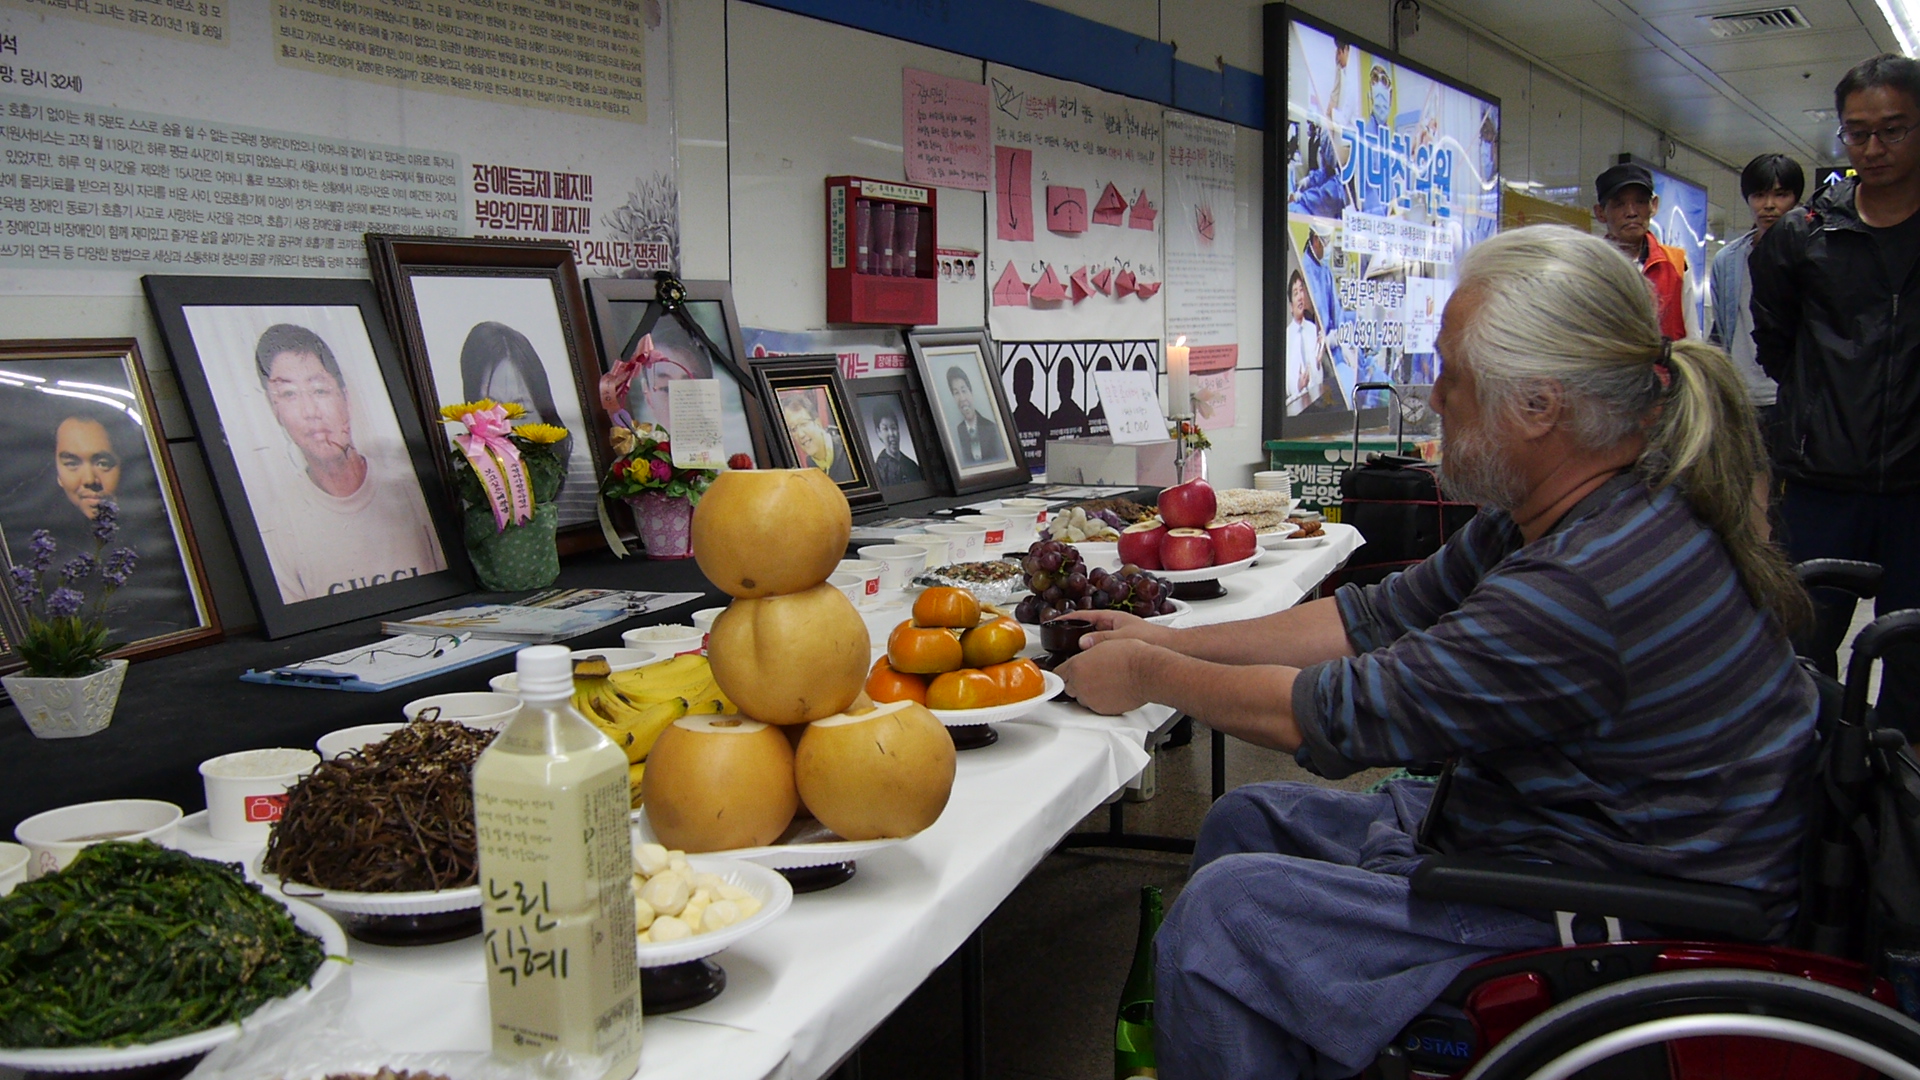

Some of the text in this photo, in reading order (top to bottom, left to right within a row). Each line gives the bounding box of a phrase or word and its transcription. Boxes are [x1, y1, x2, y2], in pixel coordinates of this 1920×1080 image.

[94, 2, 222, 40] 그녀는 결국 2013년 1월 26일
[280, 26, 304, 39] 보내고
[298, 49, 316, 62] 사는
[21, 68, 47, 89] 당시
[51, 72, 83, 93] 32세)
[1059, 96, 1077, 119] 접기
[0, 126, 66, 145] 지원서비스는
[92, 135, 102, 150] 월
[146, 142, 168, 155] 하루
[168, 145, 188, 159] 평균
[190, 148, 224, 162] 4시간이
[236, 153, 254, 166] 되지
[8, 103, 42, 119] 호흡기
[46, 107, 80, 124] 없이는
[84, 112, 94, 126] 채
[98, 115, 126, 129] 5분도
[128, 119, 158, 133] 스스로
[160, 123, 180, 137] 숨을
[196, 127, 206, 140] 수
[210, 129, 228, 143] 없는
[230, 131, 258, 146] 근육병
[350, 147, 366, 159] 같이
[368, 150, 382, 161] 살고
[408, 154, 430, 166] 이유로
[58, 155, 80, 169] 하루
[84, 157, 96, 171] 약
[98, 159, 136, 175] 9시간을
[140, 164, 170, 178] 제외한
[174, 168, 212, 182] 15시간은
[214, 171, 244, 184] 어머니
[246, 173, 264, 186] 홀로
[302, 179, 318, 192] 하는
[391, 188, 406, 199] 이미
[1341, 119, 1411, 209] 기대찬
[20, 174, 76, 192] 물리치료를
[78, 180, 110, 194] 받으러
[112, 182, 134, 196] 잠시
[136, 185, 166, 199] 자리를
[168, 187, 188, 201] 비운
[214, 191, 266, 206] 인공호흡기에
[268, 196, 294, 209] 이상이
[473, 163, 593, 202] 장애등급제 폐지!!
[0, 196, 26, 212] 육병
[28, 198, 64, 214] 장애인
[66, 200, 98, 215] 동료가
[100, 203, 132, 217] 호흡기
[134, 207, 164, 219] 사고로
[168, 209, 204, 223] 사망하는
[206, 212, 234, 225] 사건을
[266, 215, 292, 228] 호흡기
[294, 217, 310, 229] 사용
[475, 199, 591, 234] 부양의무제 폐지!!
[6, 220, 50, 235] 장애인과
[54, 223, 106, 238] 비장애인이
[108, 225, 128, 239] 함께
[130, 227, 168, 240] 재미있고
[170, 229, 198, 243] 즐거운
[220, 232, 254, 246] 살아가는
[256, 234, 274, 247] 것을
[38, 245, 60, 259] 연극
[62, 245, 74, 260] 등
[76, 247, 108, 261] 다양한
[112, 249, 150, 262] 방법으로
[152, 250, 180, 263] 세상과
[182, 251, 218, 264] 소통하며
[220, 253, 248, 265] 청년의
[250, 253, 266, 266] 꿈을
[584, 240, 631, 268] 24시간
[633, 243, 669, 270] 쟁취!!
[1341, 279, 1375, 310] 광화문역
[490, 878, 557, 933] 느린
[485, 925, 568, 986] 식혜
